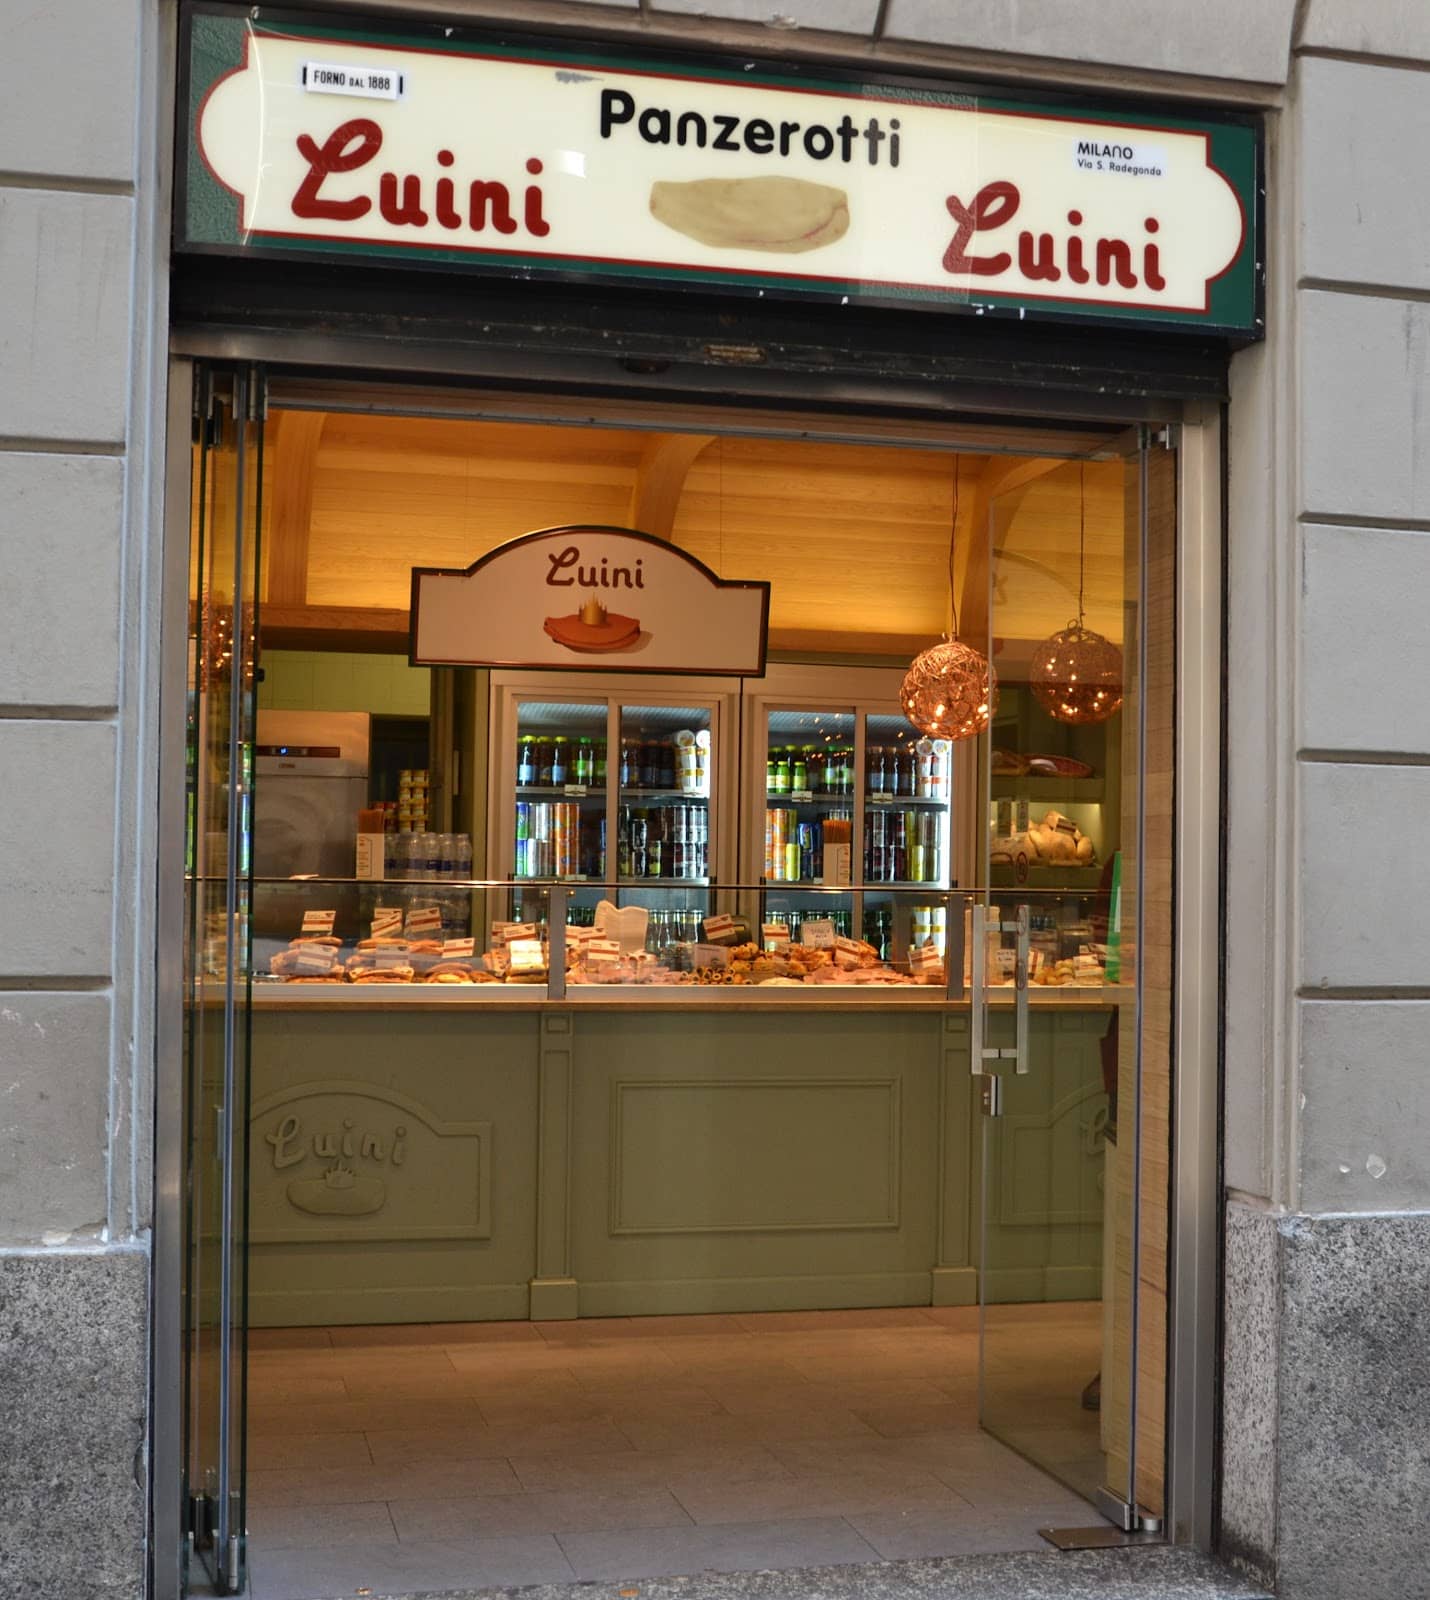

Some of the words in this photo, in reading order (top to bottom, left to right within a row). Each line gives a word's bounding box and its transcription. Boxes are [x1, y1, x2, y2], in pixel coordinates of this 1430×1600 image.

[314, 70, 346, 86] FORNO
[349, 77, 365, 88] DAL
[368, 76, 390, 90] 1888
[600, 88, 901, 168] Panzerotti
[1078, 142, 1133, 160] MILANO
[291, 118, 551, 238] Luini
[1077, 159, 1093, 169] Via
[1097, 161, 1105, 170] S.
[1109, 162, 1162, 176] Radegonda
[943, 180, 1166, 292] Luini
[545, 546, 644, 589] Luini
[265, 1114, 408, 1170] Luini
